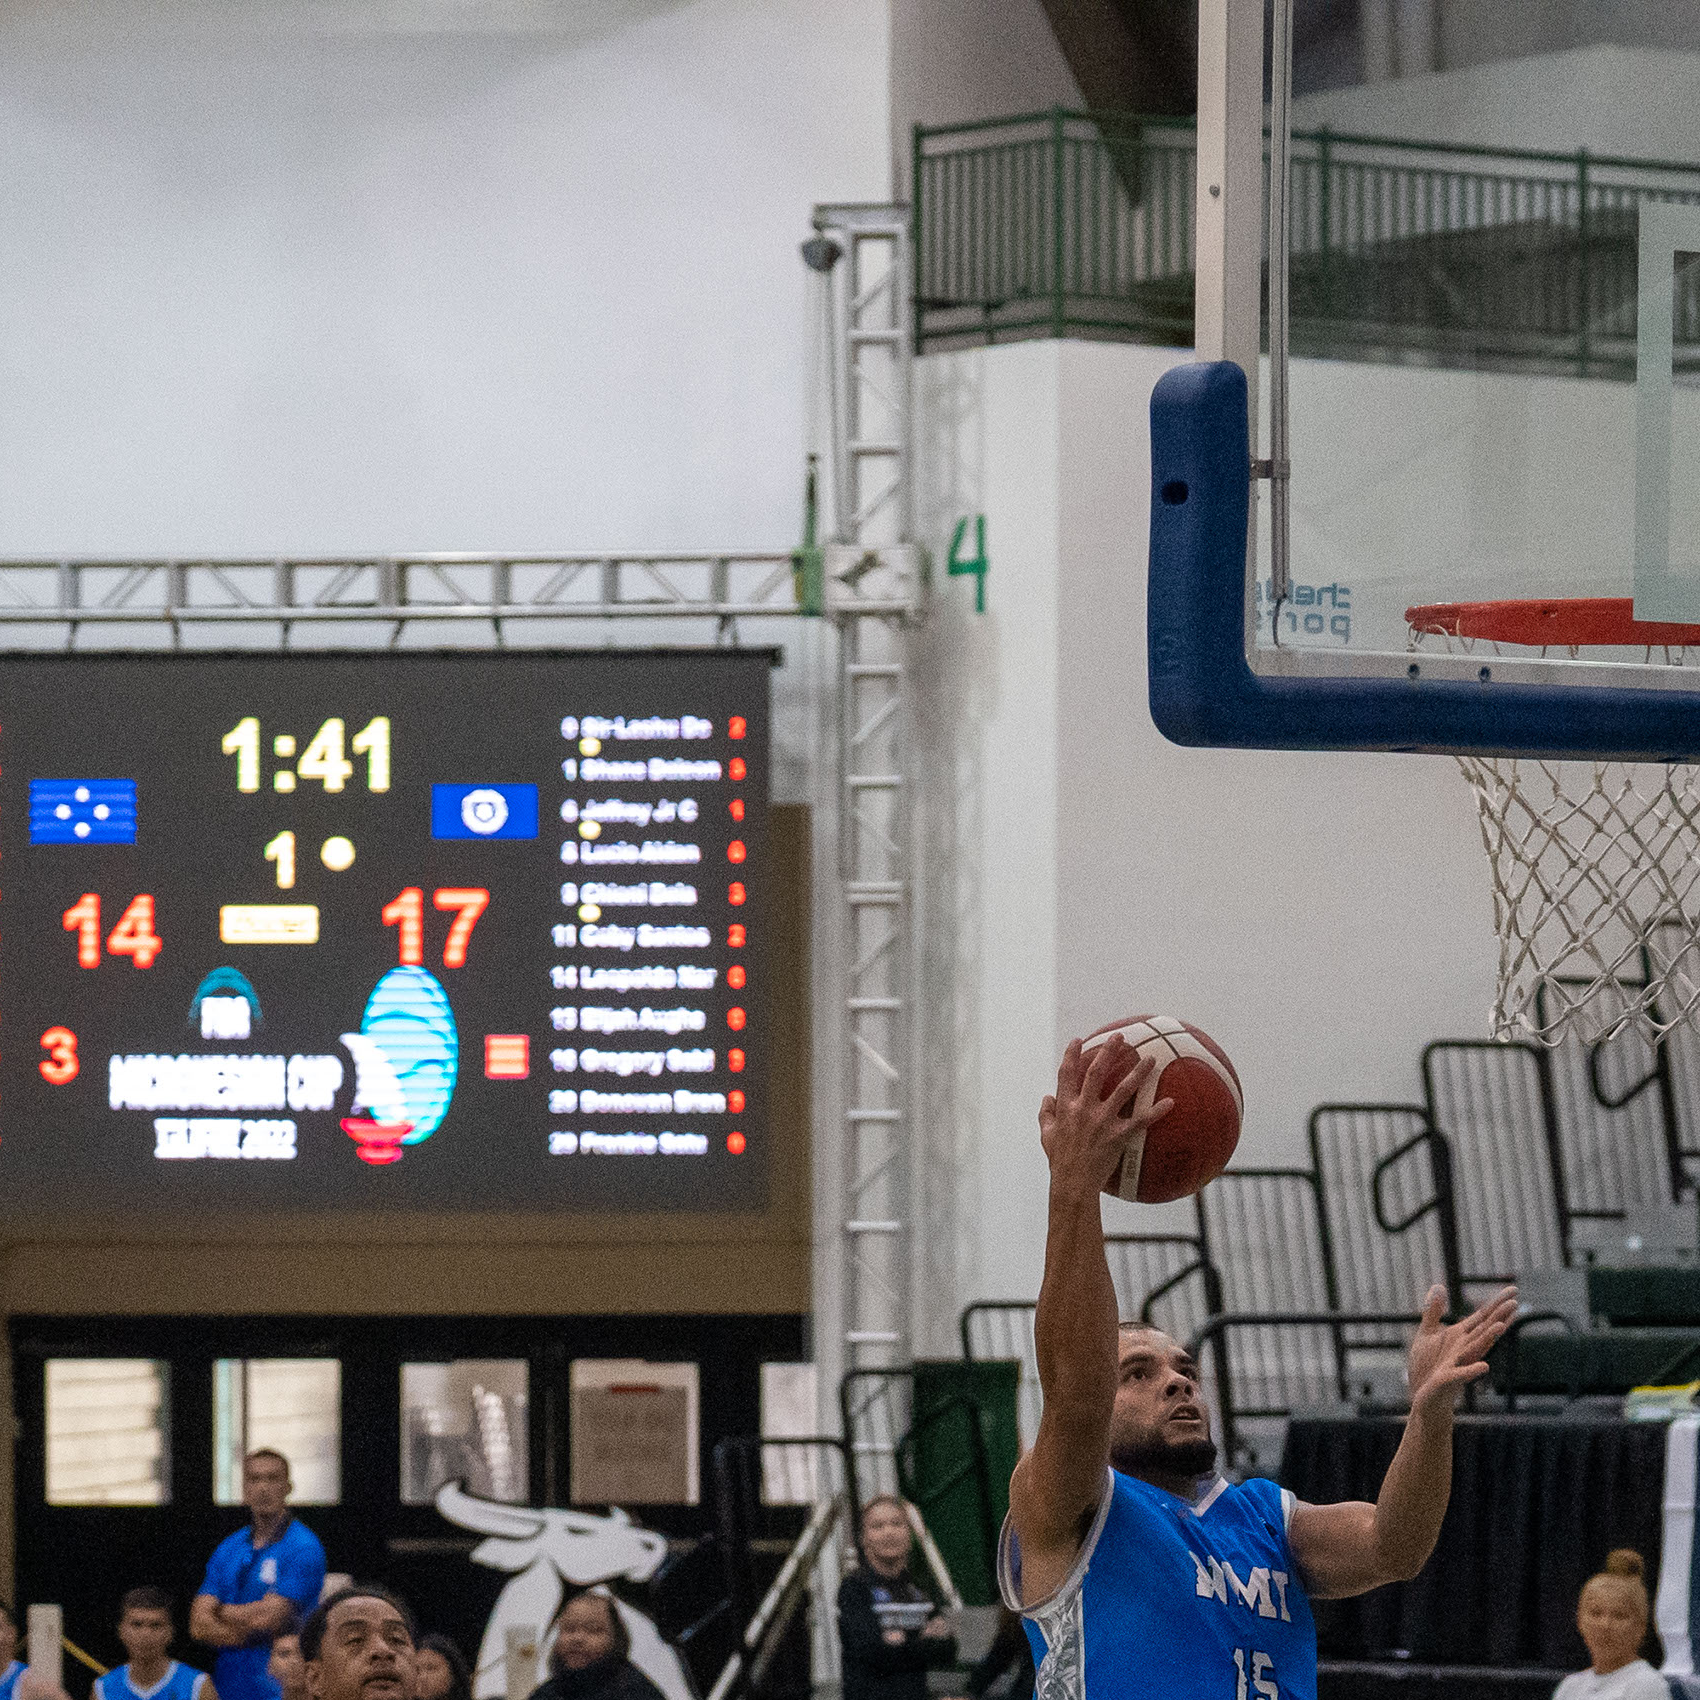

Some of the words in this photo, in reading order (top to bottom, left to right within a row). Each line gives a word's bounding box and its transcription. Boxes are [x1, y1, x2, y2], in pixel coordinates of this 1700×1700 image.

[222, 716, 390, 793] 1:41
[264, 830, 295, 889] 1
[63, 893, 162, 969] 14
[382, 886, 491, 969] 17
[39, 1026, 79, 1086] 3
[1189, 1549, 1292, 1623] NMI
